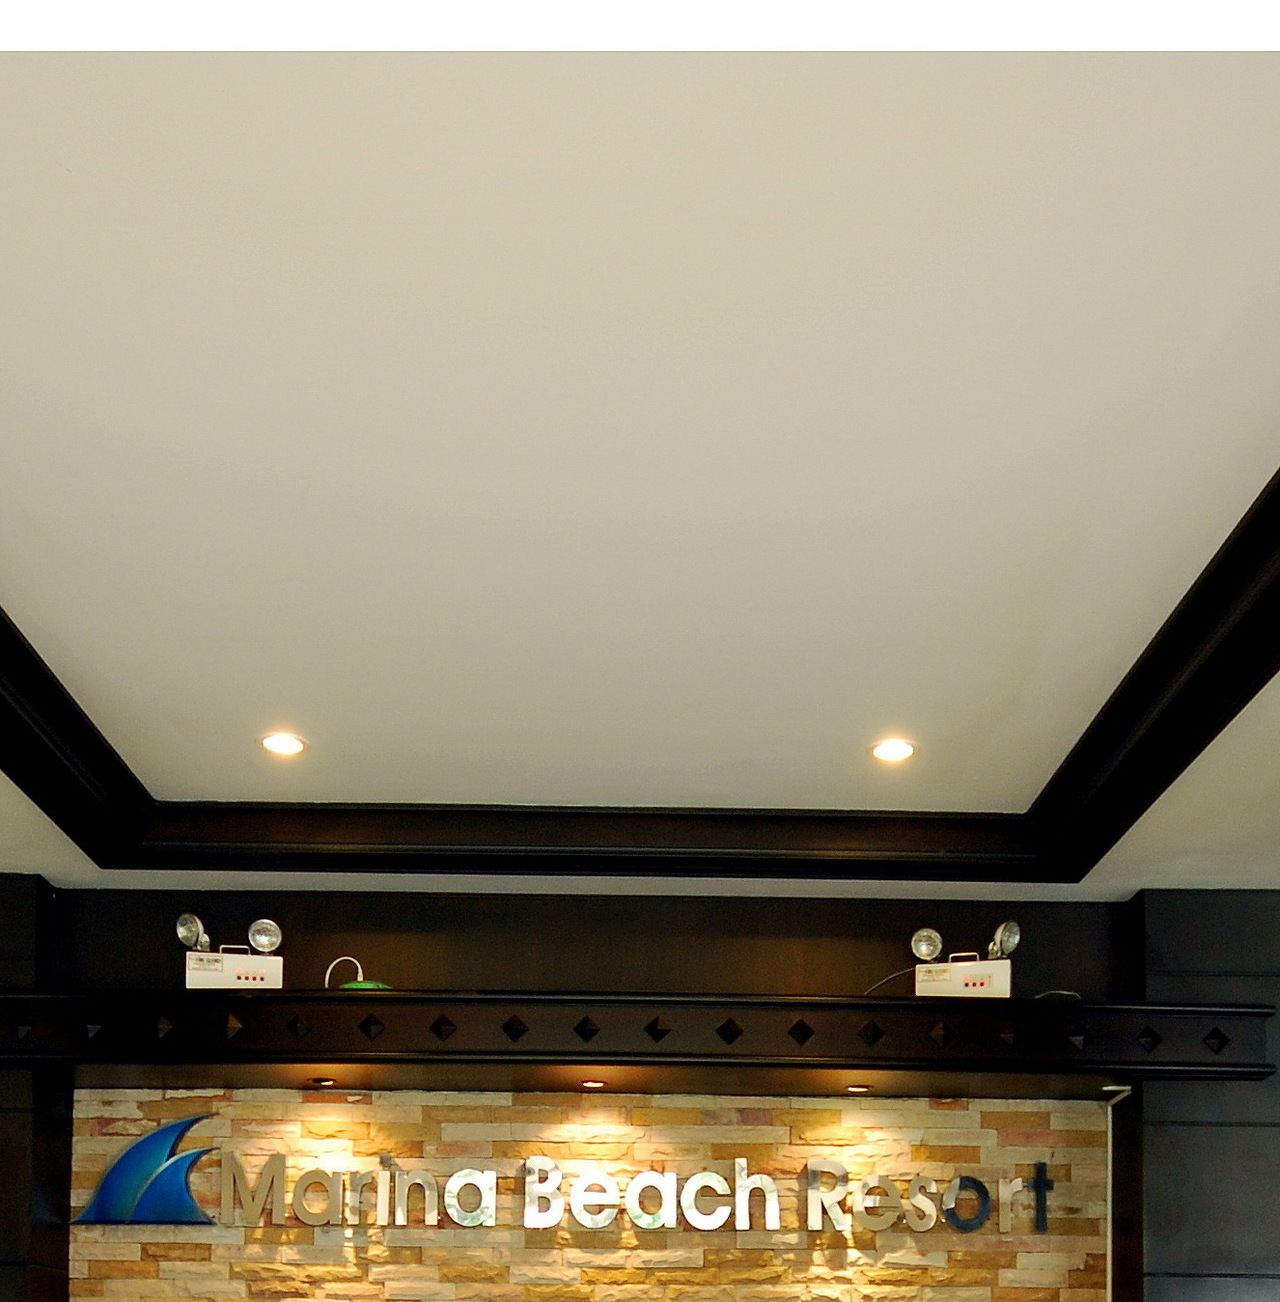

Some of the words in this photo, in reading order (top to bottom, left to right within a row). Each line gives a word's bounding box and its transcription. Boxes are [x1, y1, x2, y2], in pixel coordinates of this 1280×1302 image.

[220, 1151, 496, 1227] Marina
[523, 1155, 781, 1231] Beach
[807, 1160, 1055, 1233] Resort
